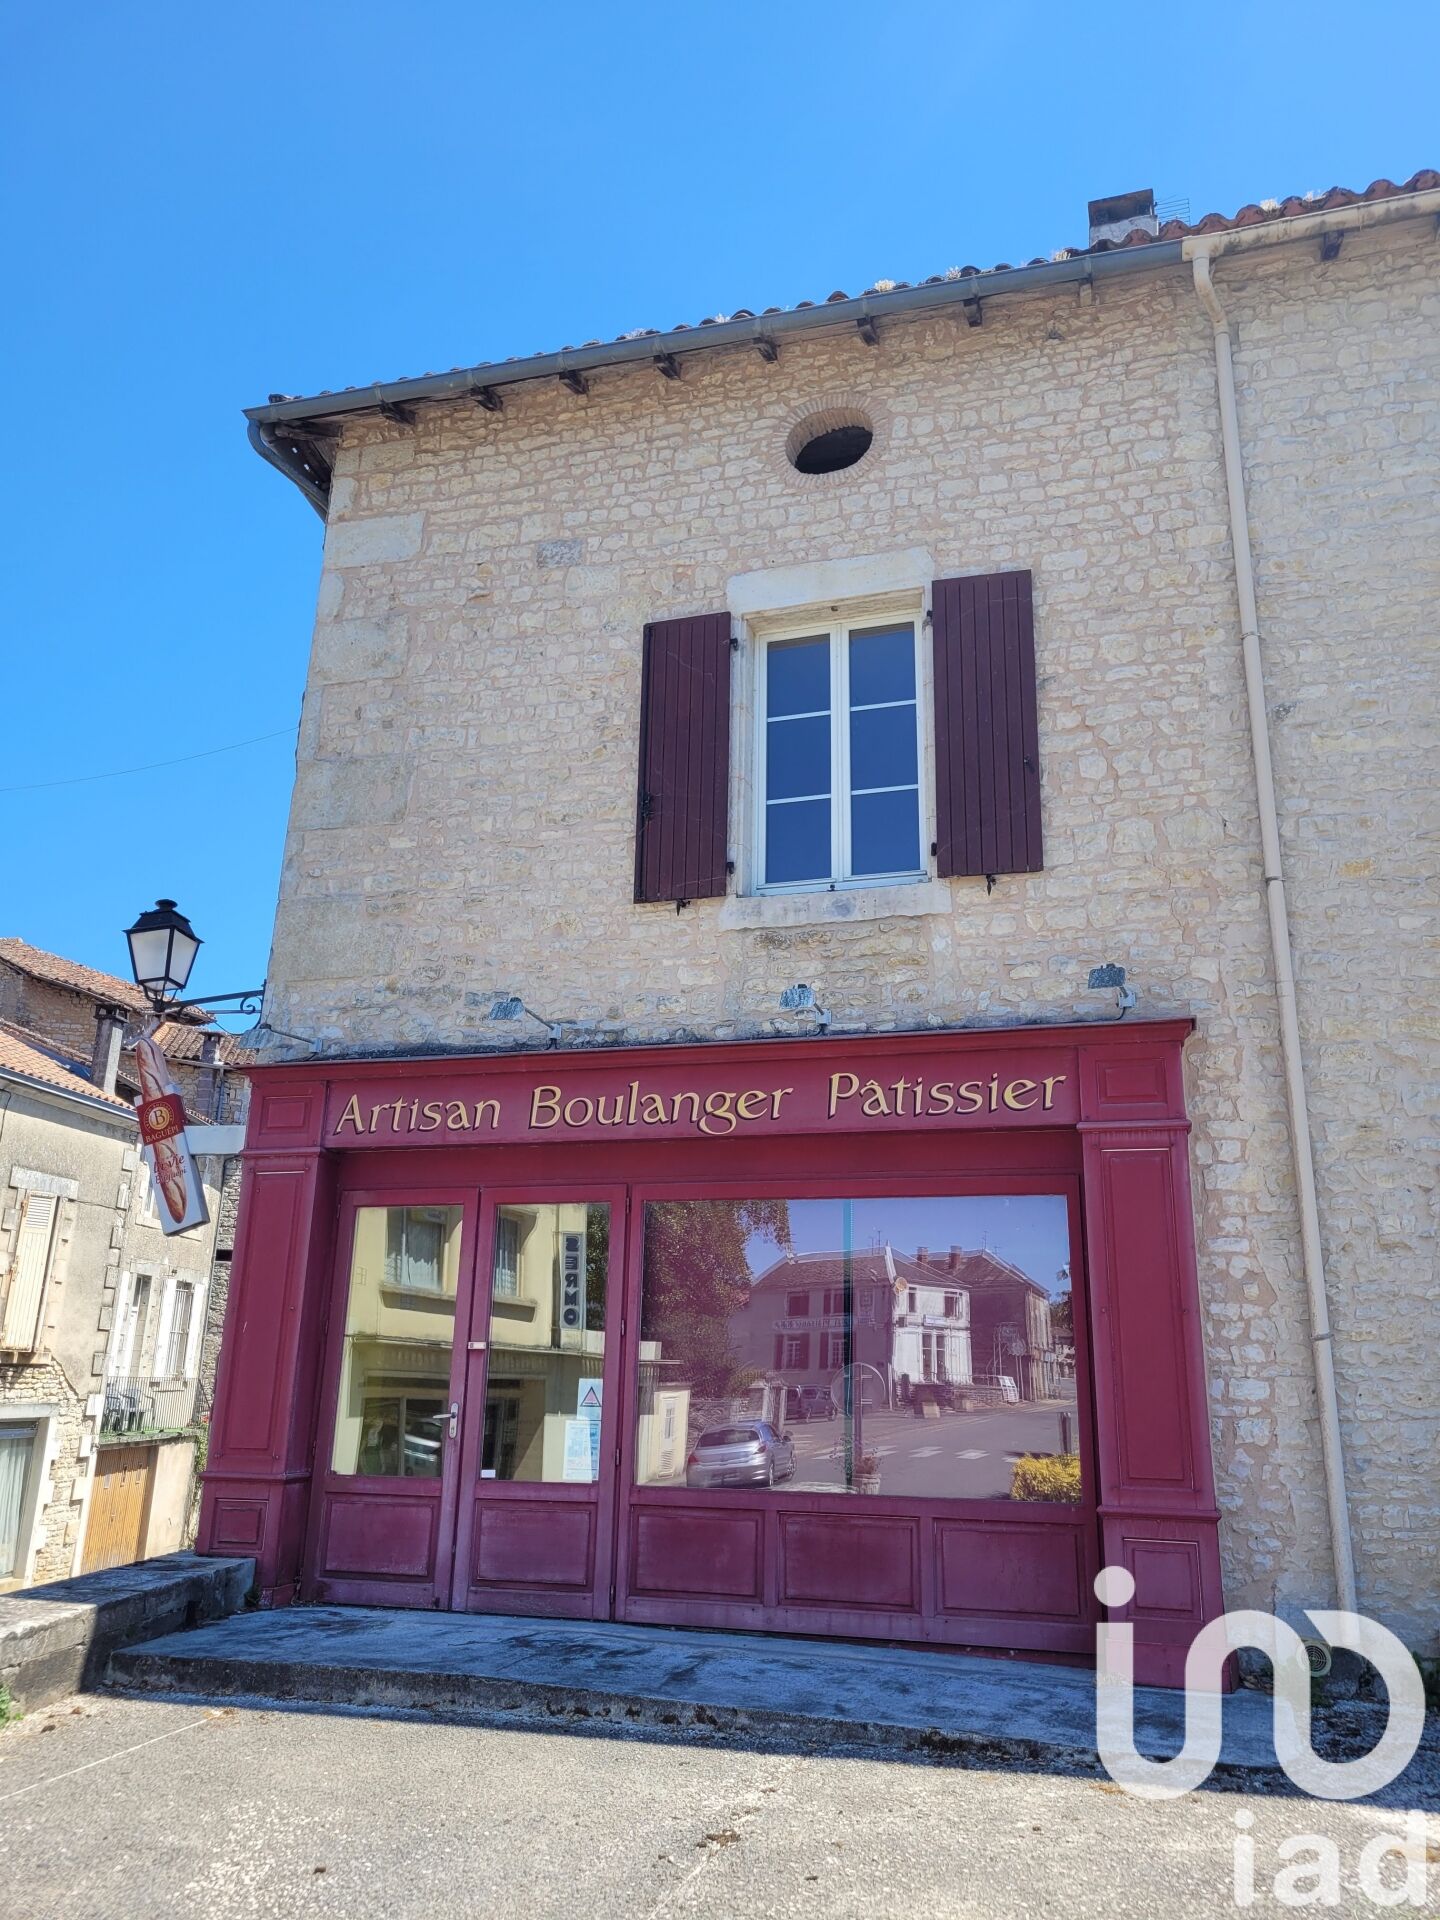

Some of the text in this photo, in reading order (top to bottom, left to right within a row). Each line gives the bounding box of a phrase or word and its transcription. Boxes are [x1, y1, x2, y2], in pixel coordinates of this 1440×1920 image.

[153, 1109, 166, 1125] B
[333, 1072, 1067, 1136] Artisan Boulanger Pâtissier
